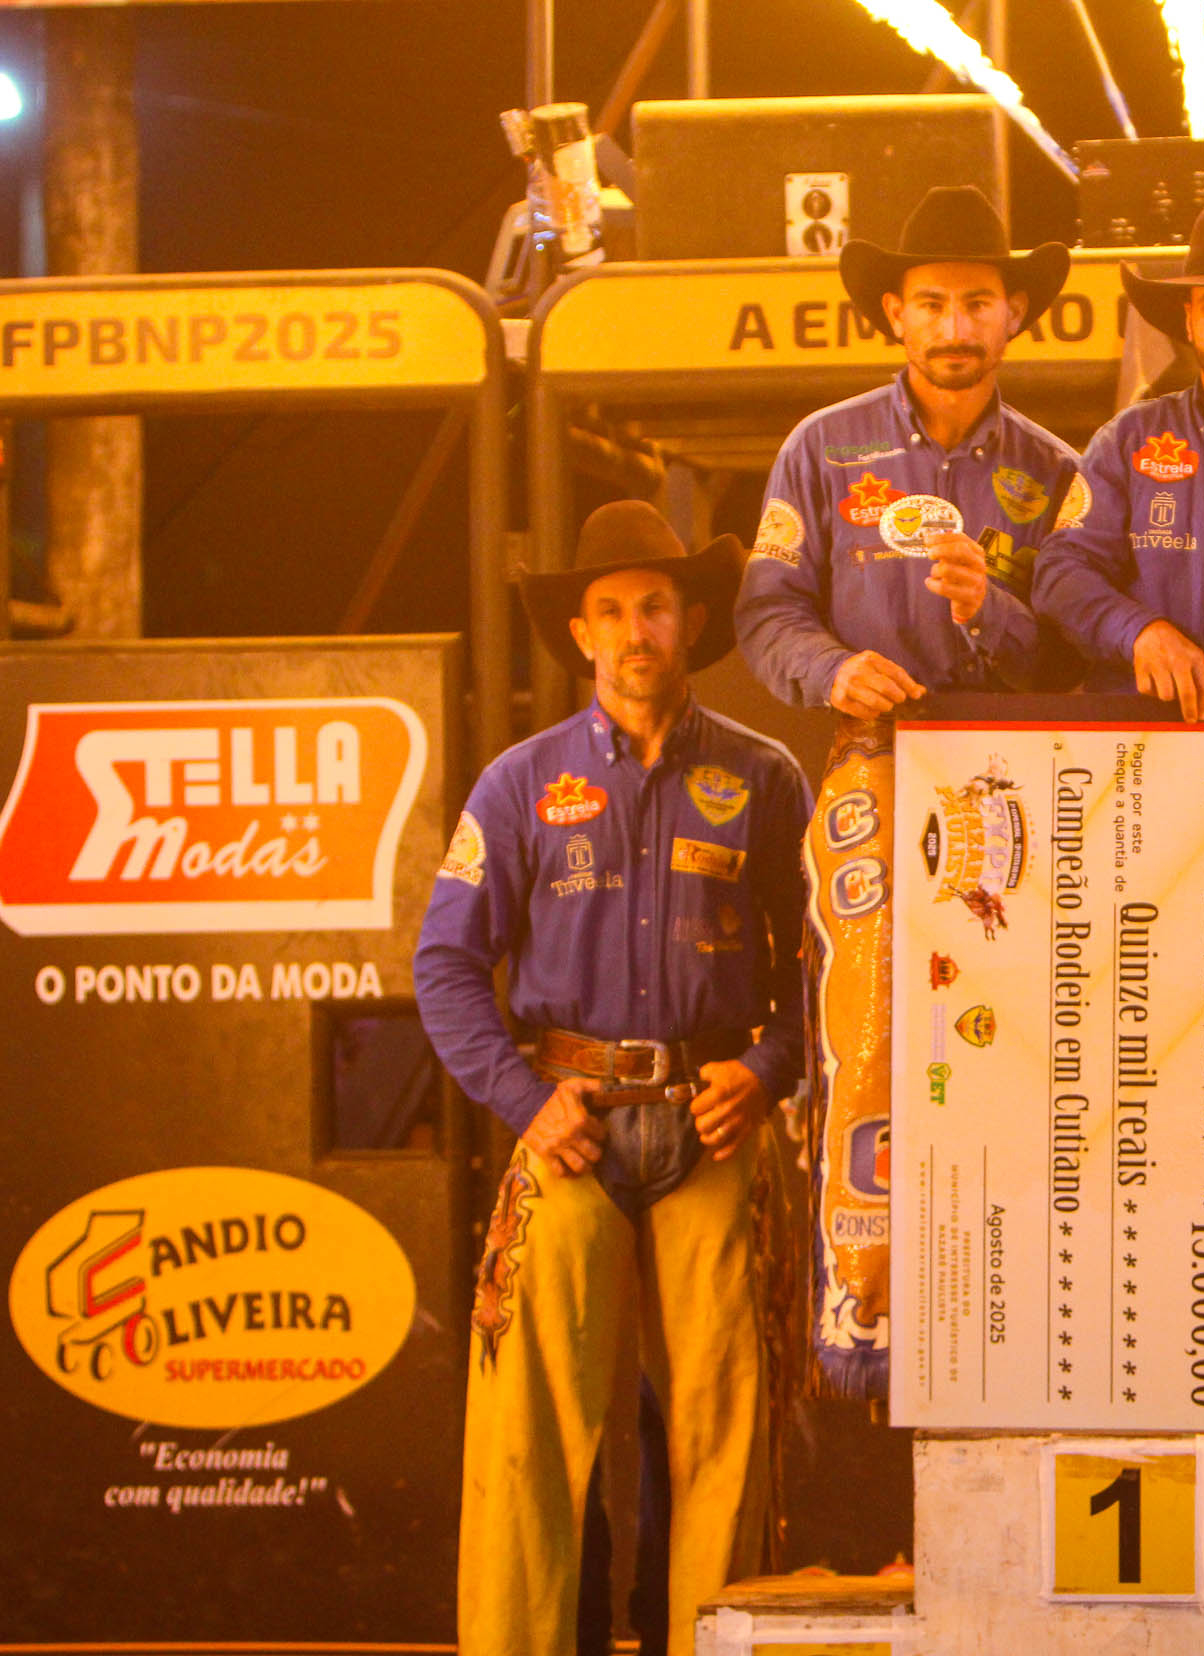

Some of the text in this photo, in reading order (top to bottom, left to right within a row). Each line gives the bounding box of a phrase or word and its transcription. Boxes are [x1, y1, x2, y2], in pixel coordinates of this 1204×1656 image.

[2, 310, 402, 367] FPBNP2025
[728, 303, 775, 351] A
[1140, 458, 1193, 474] Estrela
[75, 721, 361, 807] STELLA
[1053, 742, 1063, 751] a
[546, 800, 600, 820] Estrela
[1112, 743, 1126, 893] cheque a quantia de
[1128, 743, 1145, 854] Pague por este
[35, 962, 383, 1003] O PONTO DA MODA
[1050, 767, 1093, 1213] Campeão Rodeio em Cutiano
[1116, 902, 1159, 1186] Quinze mil reais
[986, 1204, 1006, 1345] Agosto de 2025
[165, 1358, 366, 1383] SUPERMERCADO
[140, 1441, 289, 1471] "Economia
[104, 1477, 327, 1514] com qualidade!"
[1088, 1466, 1142, 1584] 1
